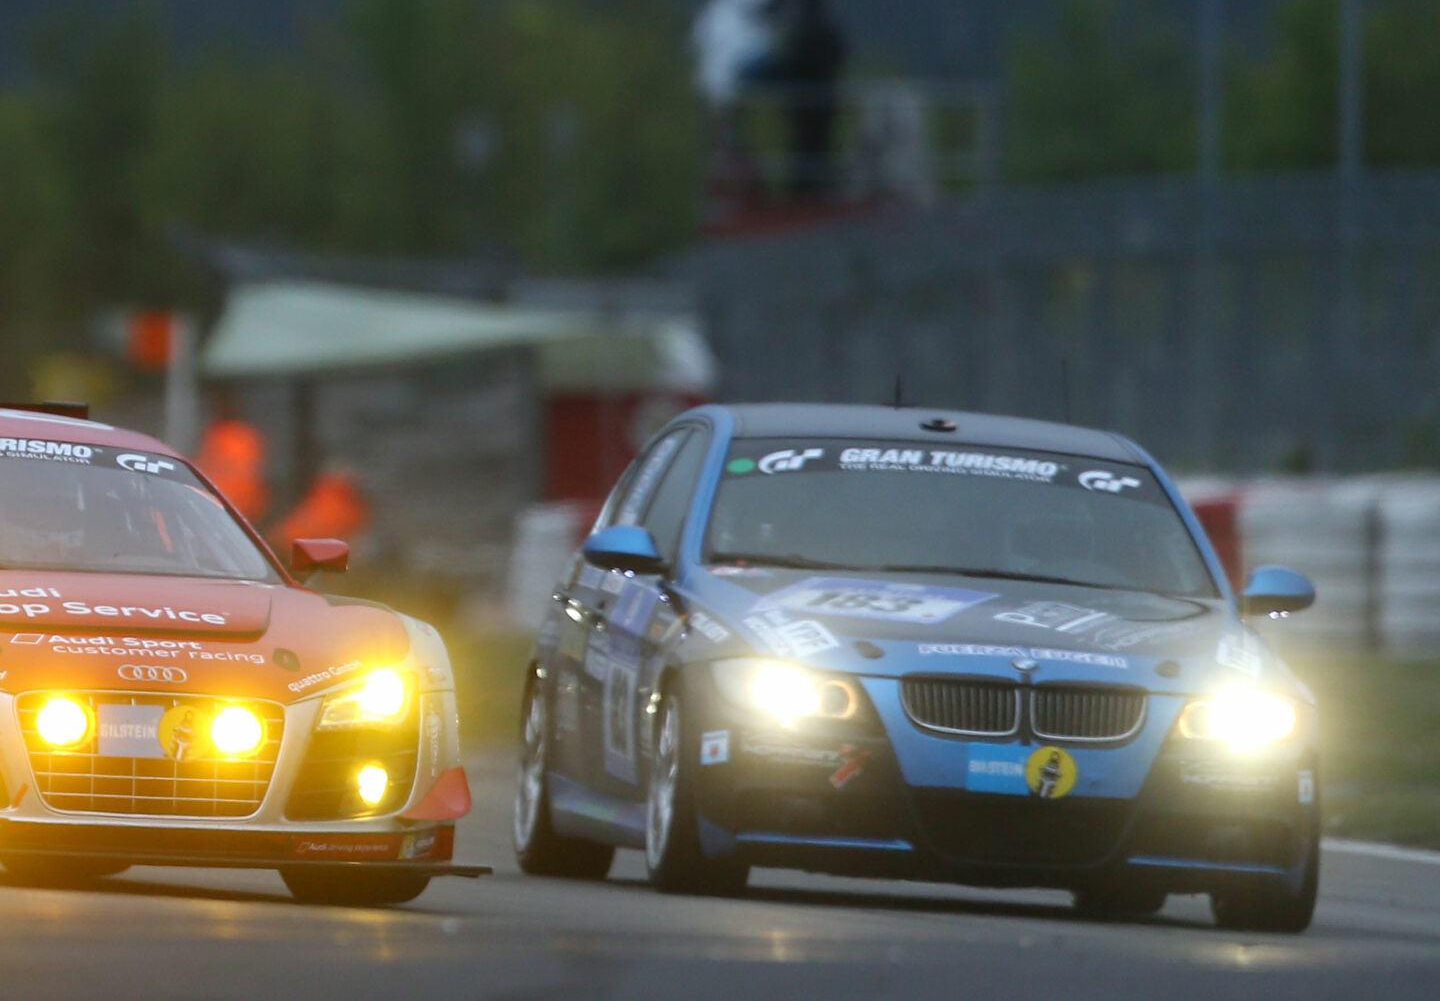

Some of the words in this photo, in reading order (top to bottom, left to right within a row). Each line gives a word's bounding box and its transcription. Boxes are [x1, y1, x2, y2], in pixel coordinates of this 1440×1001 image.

[6, 451, 91, 465] SIMULATOR
[840, 447, 923, 465] GRAN
[930, 450, 1059, 478] TURISMO
[62, 601, 227, 626] Service
[48, 634, 114, 647] Audi
[123, 636, 203, 651] Sport
[52, 645, 181, 660] customer
[189, 648, 266, 665] racing
[287, 669, 330, 693] quattro
[100, 722, 157, 740] BILSTEIN
[968, 759, 1024, 777] BILSTEIN
